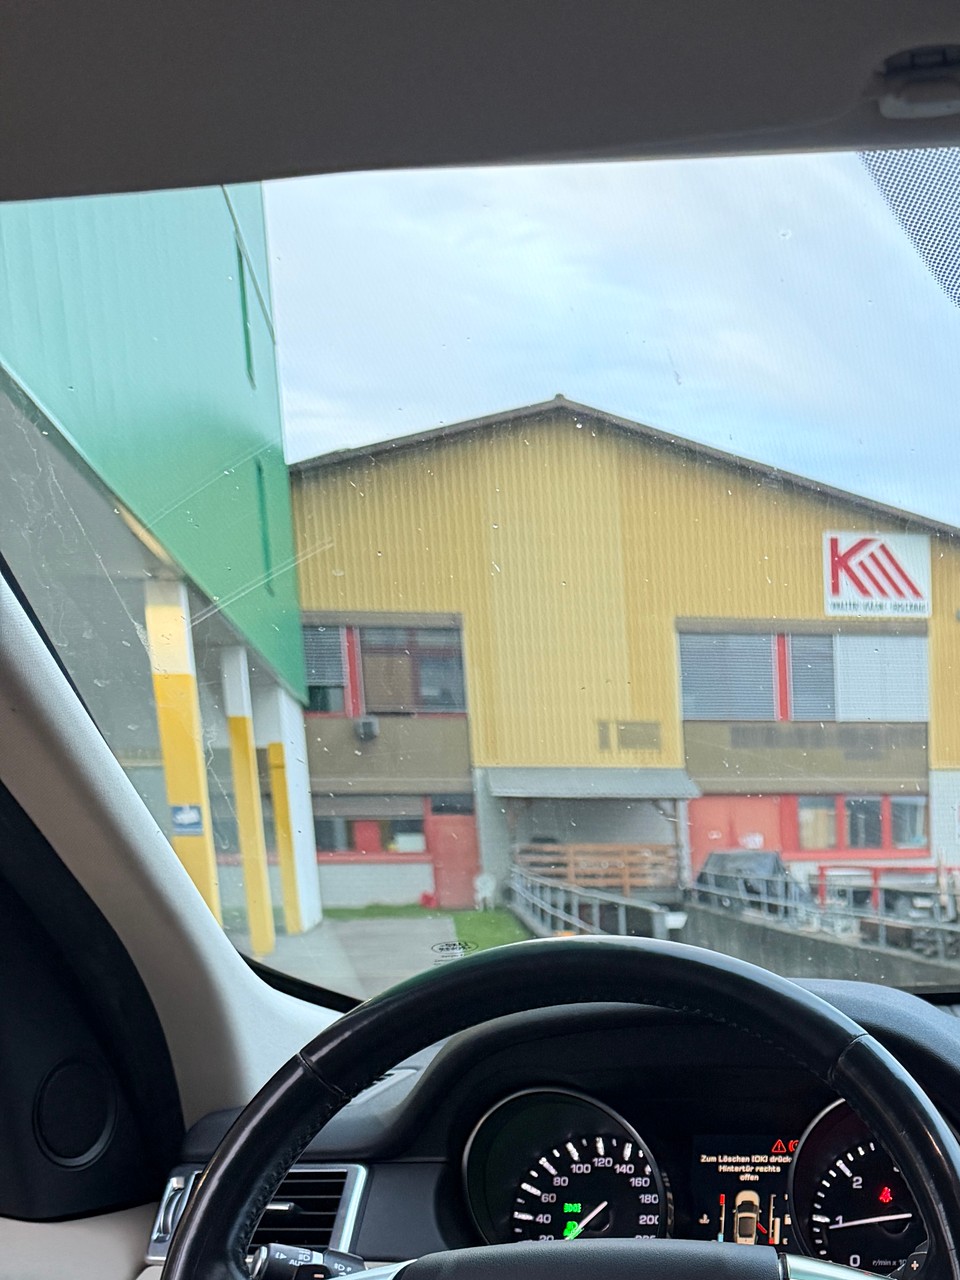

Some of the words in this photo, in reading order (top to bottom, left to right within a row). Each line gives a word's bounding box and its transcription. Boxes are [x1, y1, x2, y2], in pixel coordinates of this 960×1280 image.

[592, 1157, 613, 1168] 120
[700, 1155, 717, 1163] Zum
[718, 1154, 750, 1163] Löschen
[769, 1154, 793, 1163] drück
[570, 1163, 591, 1174] 100
[614, 1164, 634, 1174] 140
[718, 1165, 754, 1173] Hintertür
[755, 1165, 781, 1173] rechts
[553, 1176, 569, 1187] 80
[629, 1177, 650, 1187] 160
[739, 1174, 760, 1182] offen
[852, 1176, 863, 1189] 2
[541, 1192, 557, 1203] 60
[639, 1193, 659, 1204] 180
[535, 1213, 551, 1224] 40
[849, 1254, 861, 1268] 0
